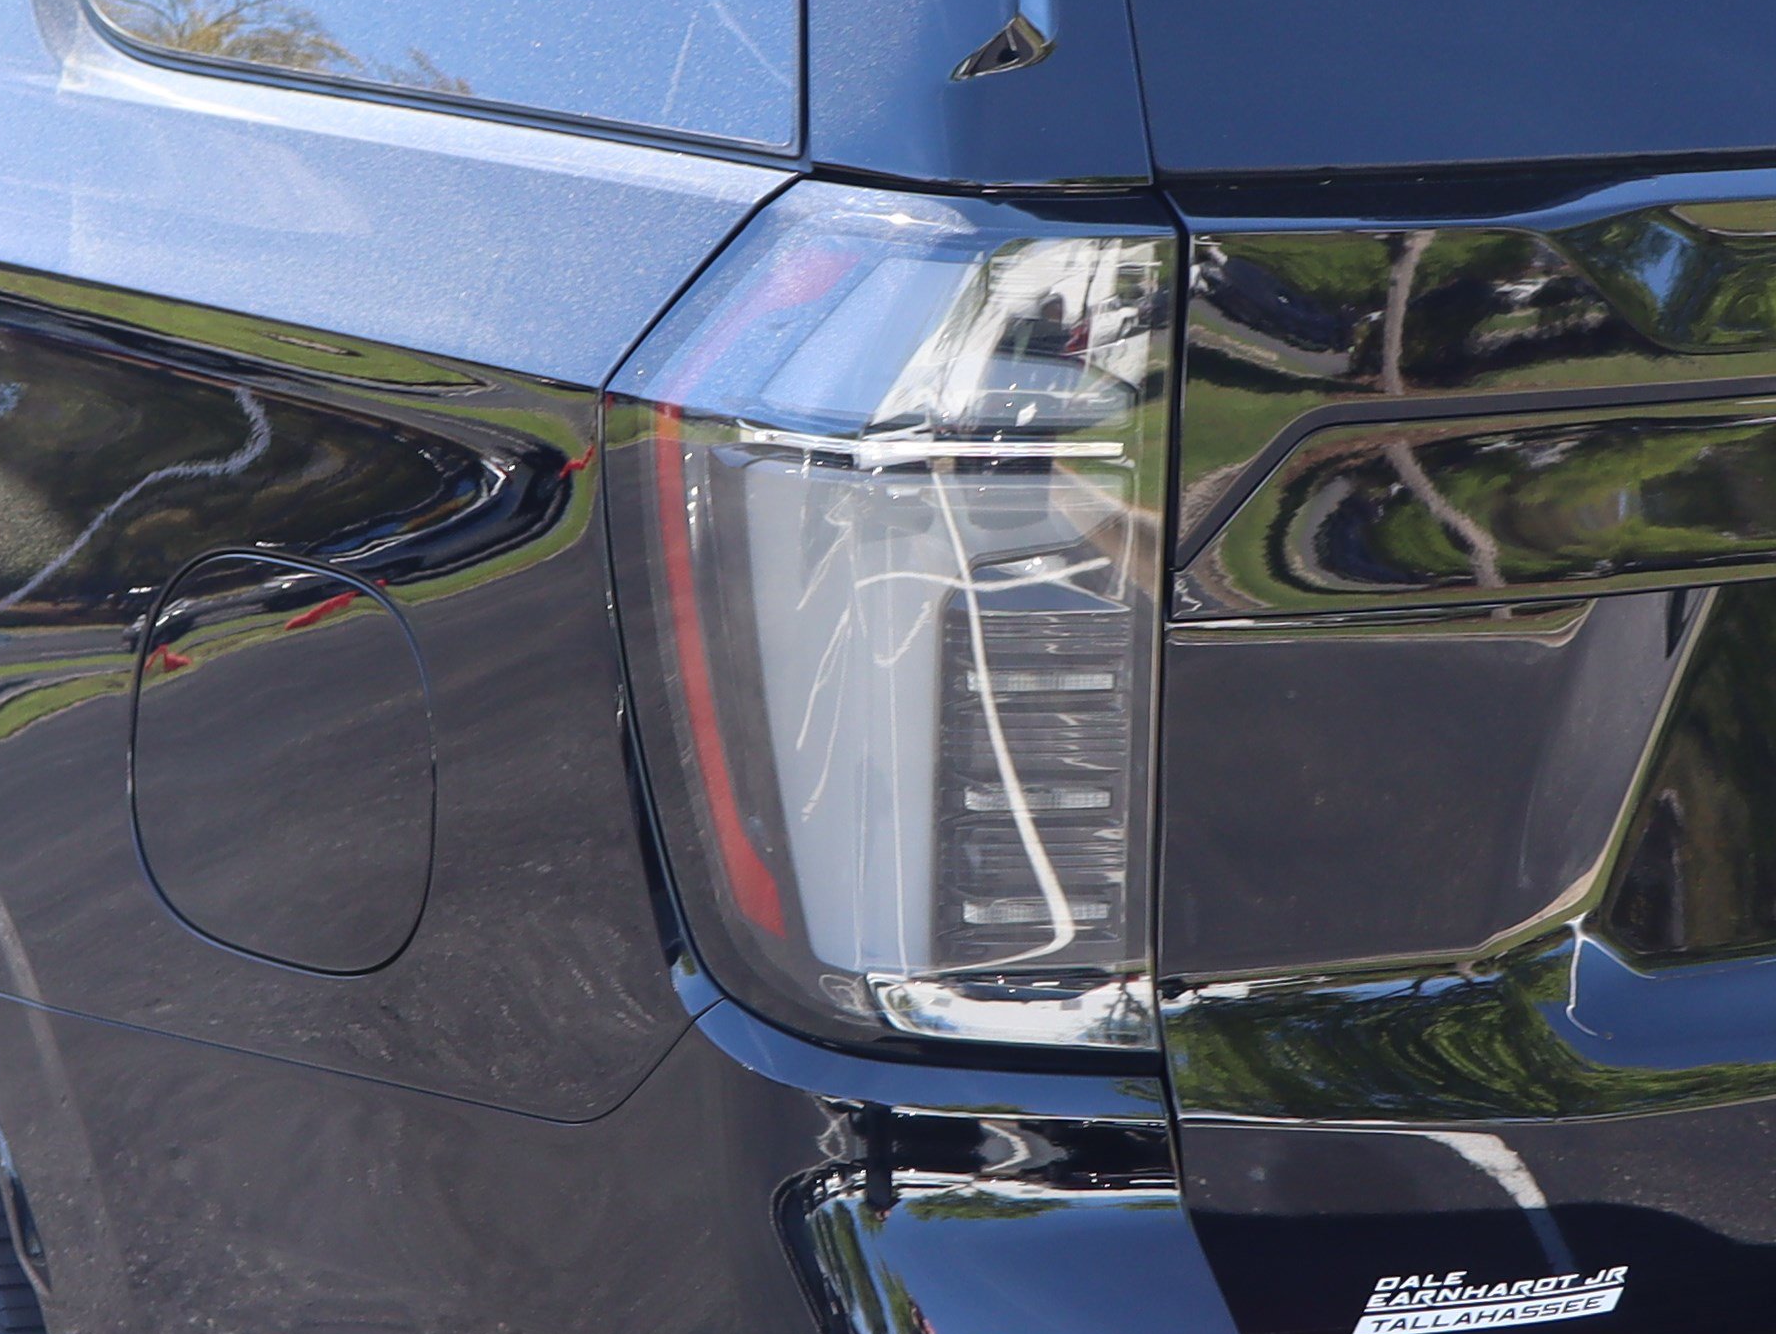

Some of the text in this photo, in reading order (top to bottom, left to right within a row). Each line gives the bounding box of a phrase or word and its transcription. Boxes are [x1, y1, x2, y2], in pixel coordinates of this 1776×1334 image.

[1366, 1266, 1629, 1309] EARNHARDT JR
[1373, 1270, 1468, 1292] DALE
[1371, 1294, 1607, 1333] TALLAHASSEE
